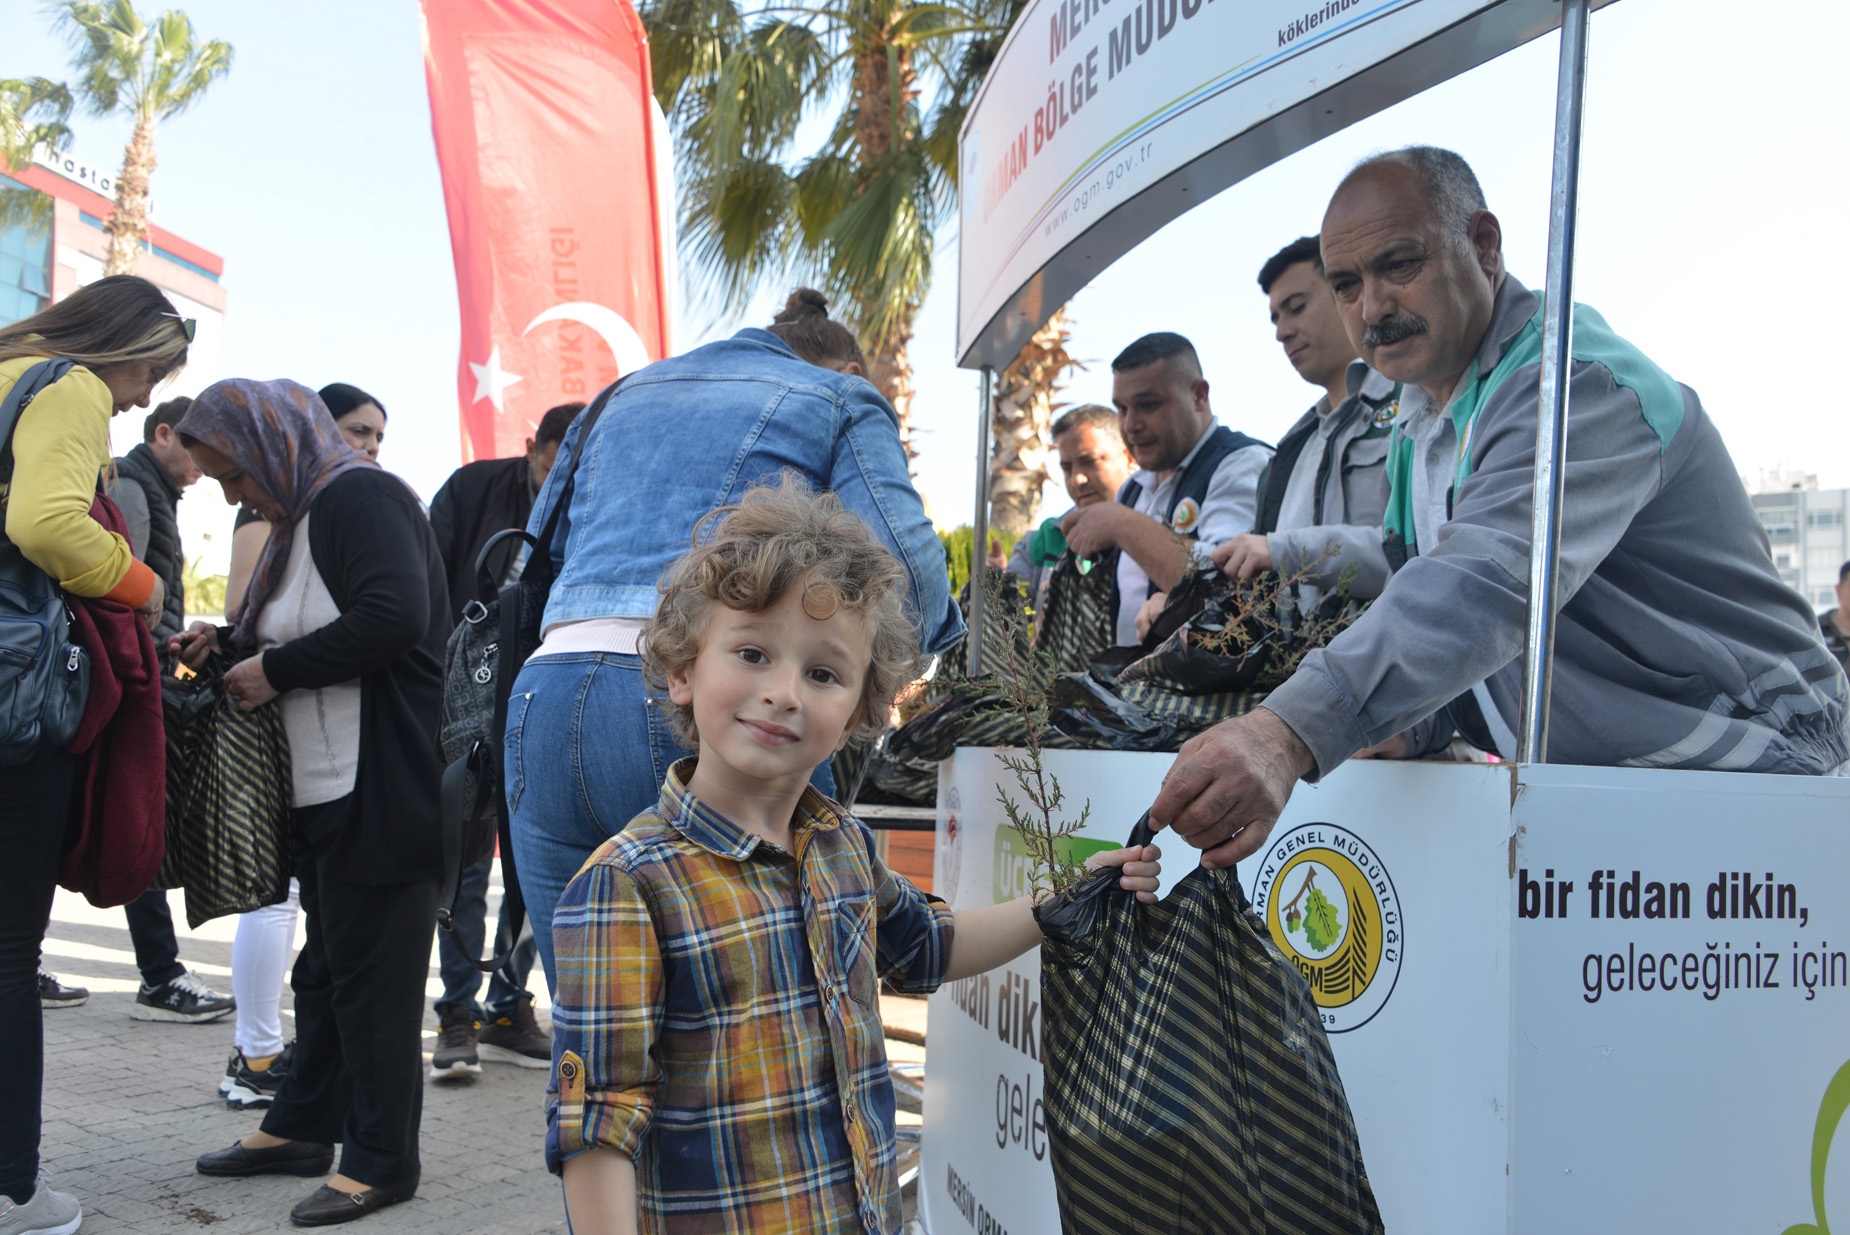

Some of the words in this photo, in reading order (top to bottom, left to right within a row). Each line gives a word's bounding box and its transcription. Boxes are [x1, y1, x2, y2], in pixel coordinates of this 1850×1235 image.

[1278, 0, 1360, 47] köklerin
[1034, 45, 1098, 157] BÖLGE
[1108, 0, 1215, 81] MÜD
[1045, 142, 1152, 237] www.ogm.gov.tr
[1277, 831, 1325, 860] GENEL
[1333, 834, 1399, 963] MÜDÜRLÜĞÜ
[1518, 869, 1573, 919] bir
[1588, 870, 1691, 919] fidan
[1706, 872, 1809, 928] dikin,
[1582, 941, 1779, 1003] geleceğiniz
[1792, 941, 1850, 1001] için
[947, 1162, 976, 1228] MERSİN
